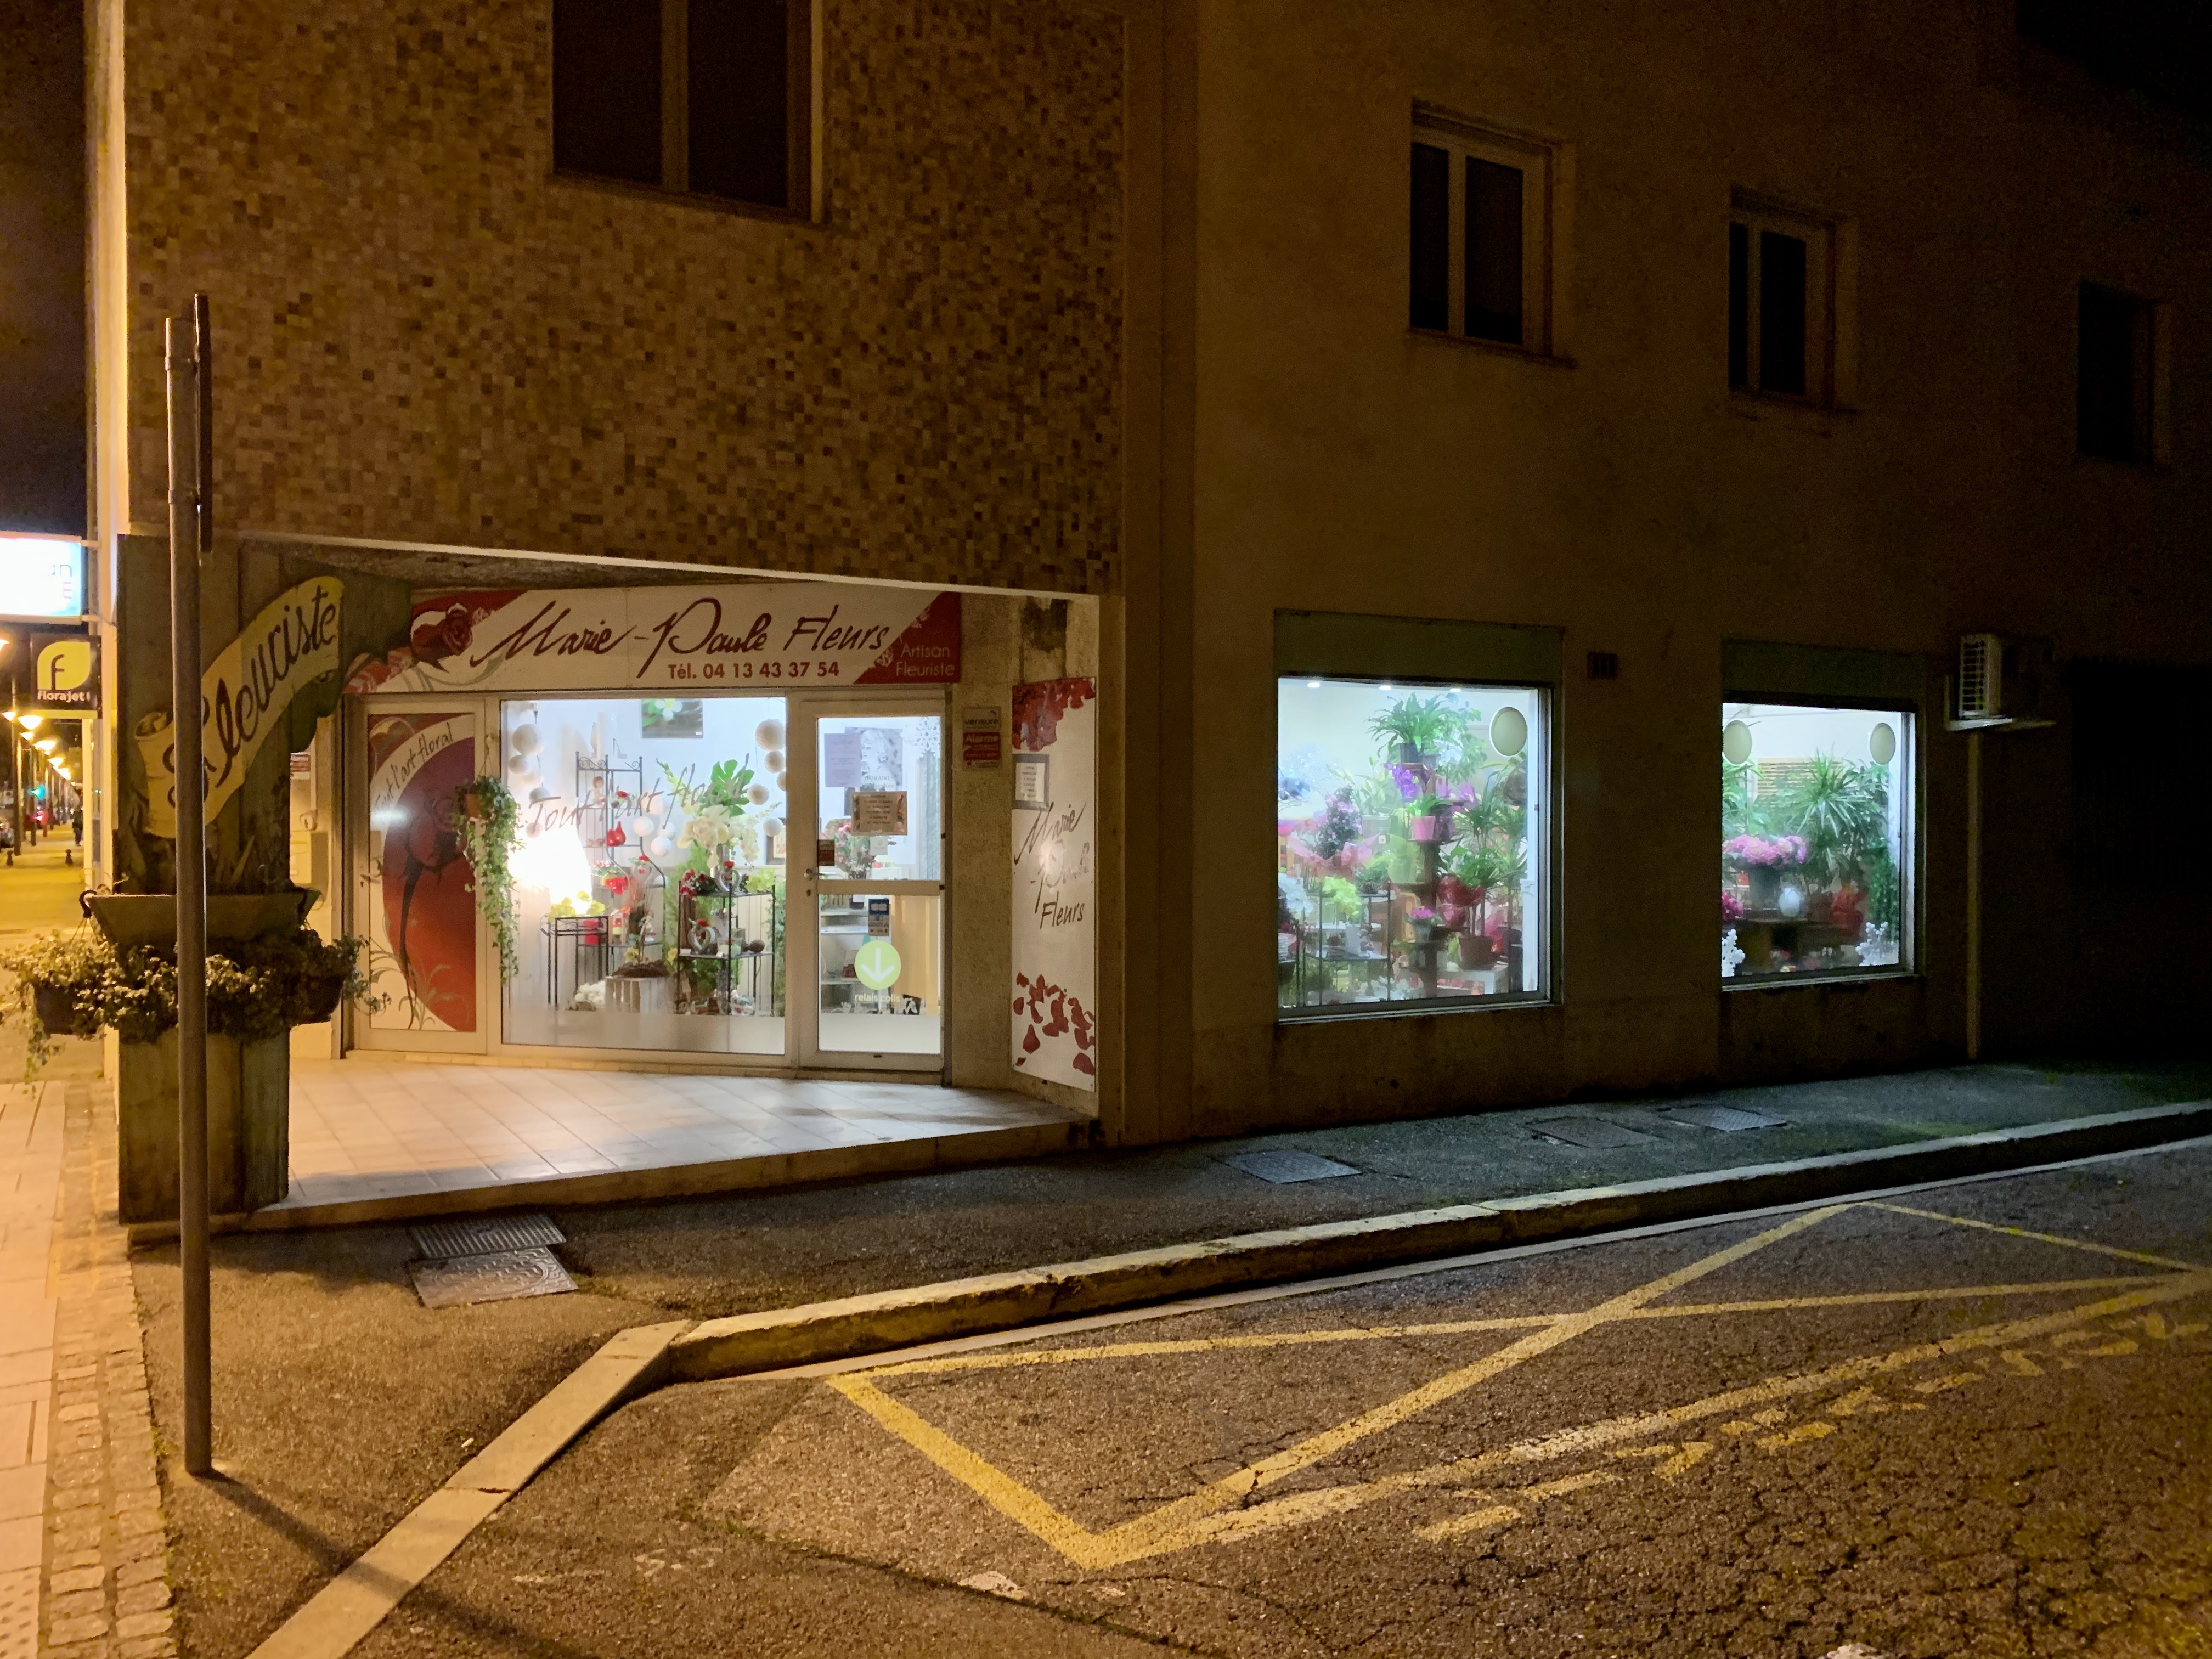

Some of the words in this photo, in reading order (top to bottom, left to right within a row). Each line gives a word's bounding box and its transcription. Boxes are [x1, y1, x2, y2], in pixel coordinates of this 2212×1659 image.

[783, 604, 890, 652] Fleurs
[900, 644, 950, 658] Artisan
[668, 663, 696, 680] Tél.
[703, 664, 724, 679] 04
[733, 663, 753, 678] 13
[759, 663, 782, 678] 43
[789, 662, 810, 677] 37
[817, 662, 839, 677] 54
[896, 661, 955, 676] Fleuriste
[37, 690, 85, 703] florajet
[965, 733, 999, 743] Alarme
[390, 748, 416, 789] l'art
[418, 721, 454, 763] floral
[528, 788, 591, 835] Tout
[1014, 800, 1087, 865] Marie
[1040, 890, 1085, 929] Fleurs
[854, 992, 878, 1002] relais
[880, 994, 901, 1003] colis
